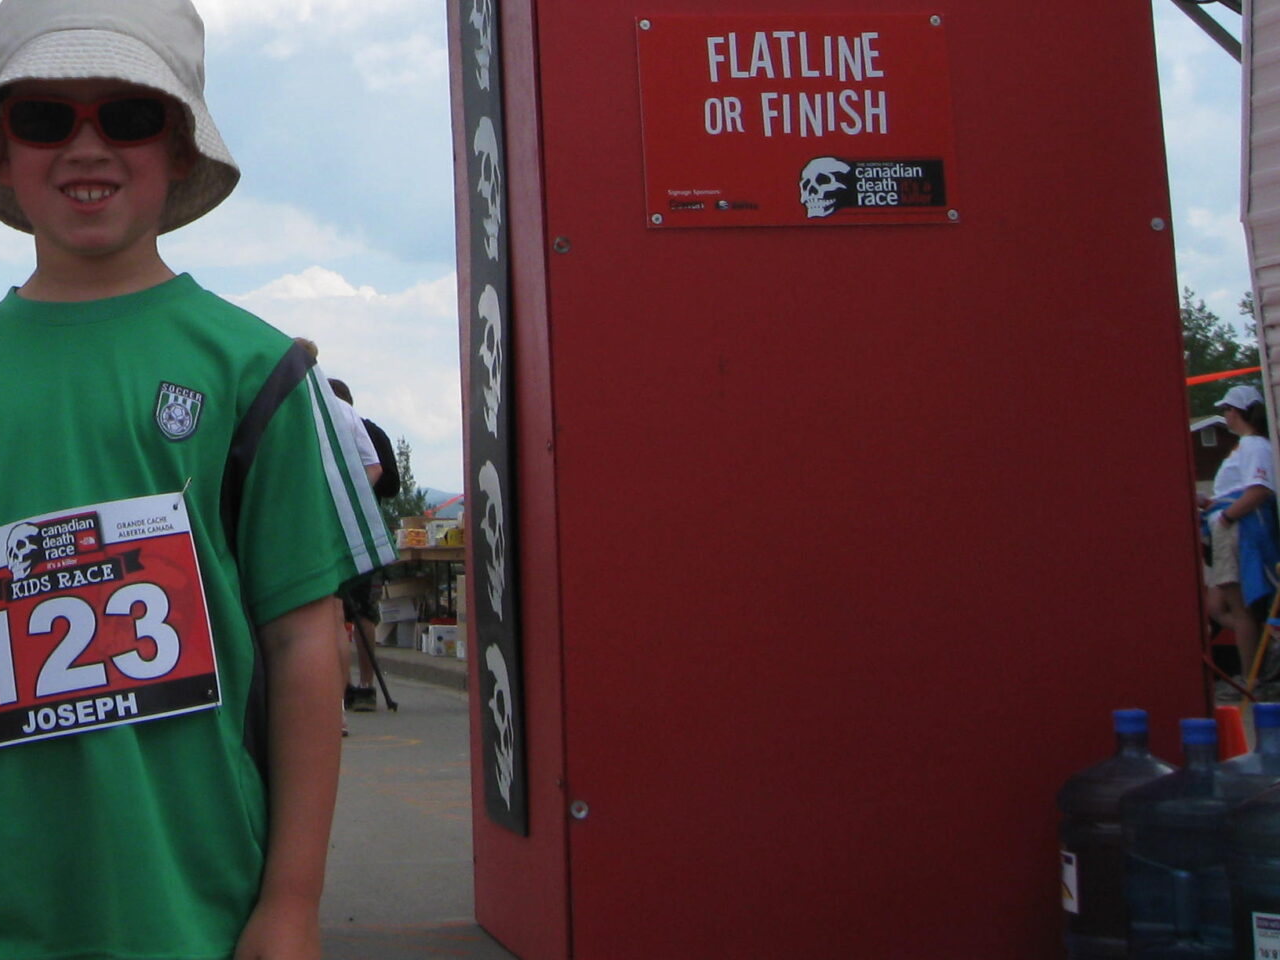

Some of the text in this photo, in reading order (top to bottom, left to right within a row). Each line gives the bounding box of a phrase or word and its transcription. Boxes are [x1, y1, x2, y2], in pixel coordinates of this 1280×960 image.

[706, 31, 884, 83] FLATLINE
[704, 89, 888, 138] OR FINISH
[855, 163, 923, 178] canadian
[856, 178, 898, 192] death
[857, 192, 898, 206] race
[161, 382, 203, 402] SOCCER
[41, 518, 94, 537] canadian
[116, 516, 167, 530] GRANDE CACHE
[118, 523, 174, 538] ALBERTA CANADA
[42, 533, 75, 549] death
[45, 545, 75, 560] race
[11, 563, 115, 600] KIDS RACE
[22, 692, 138, 734] JOSEPH
